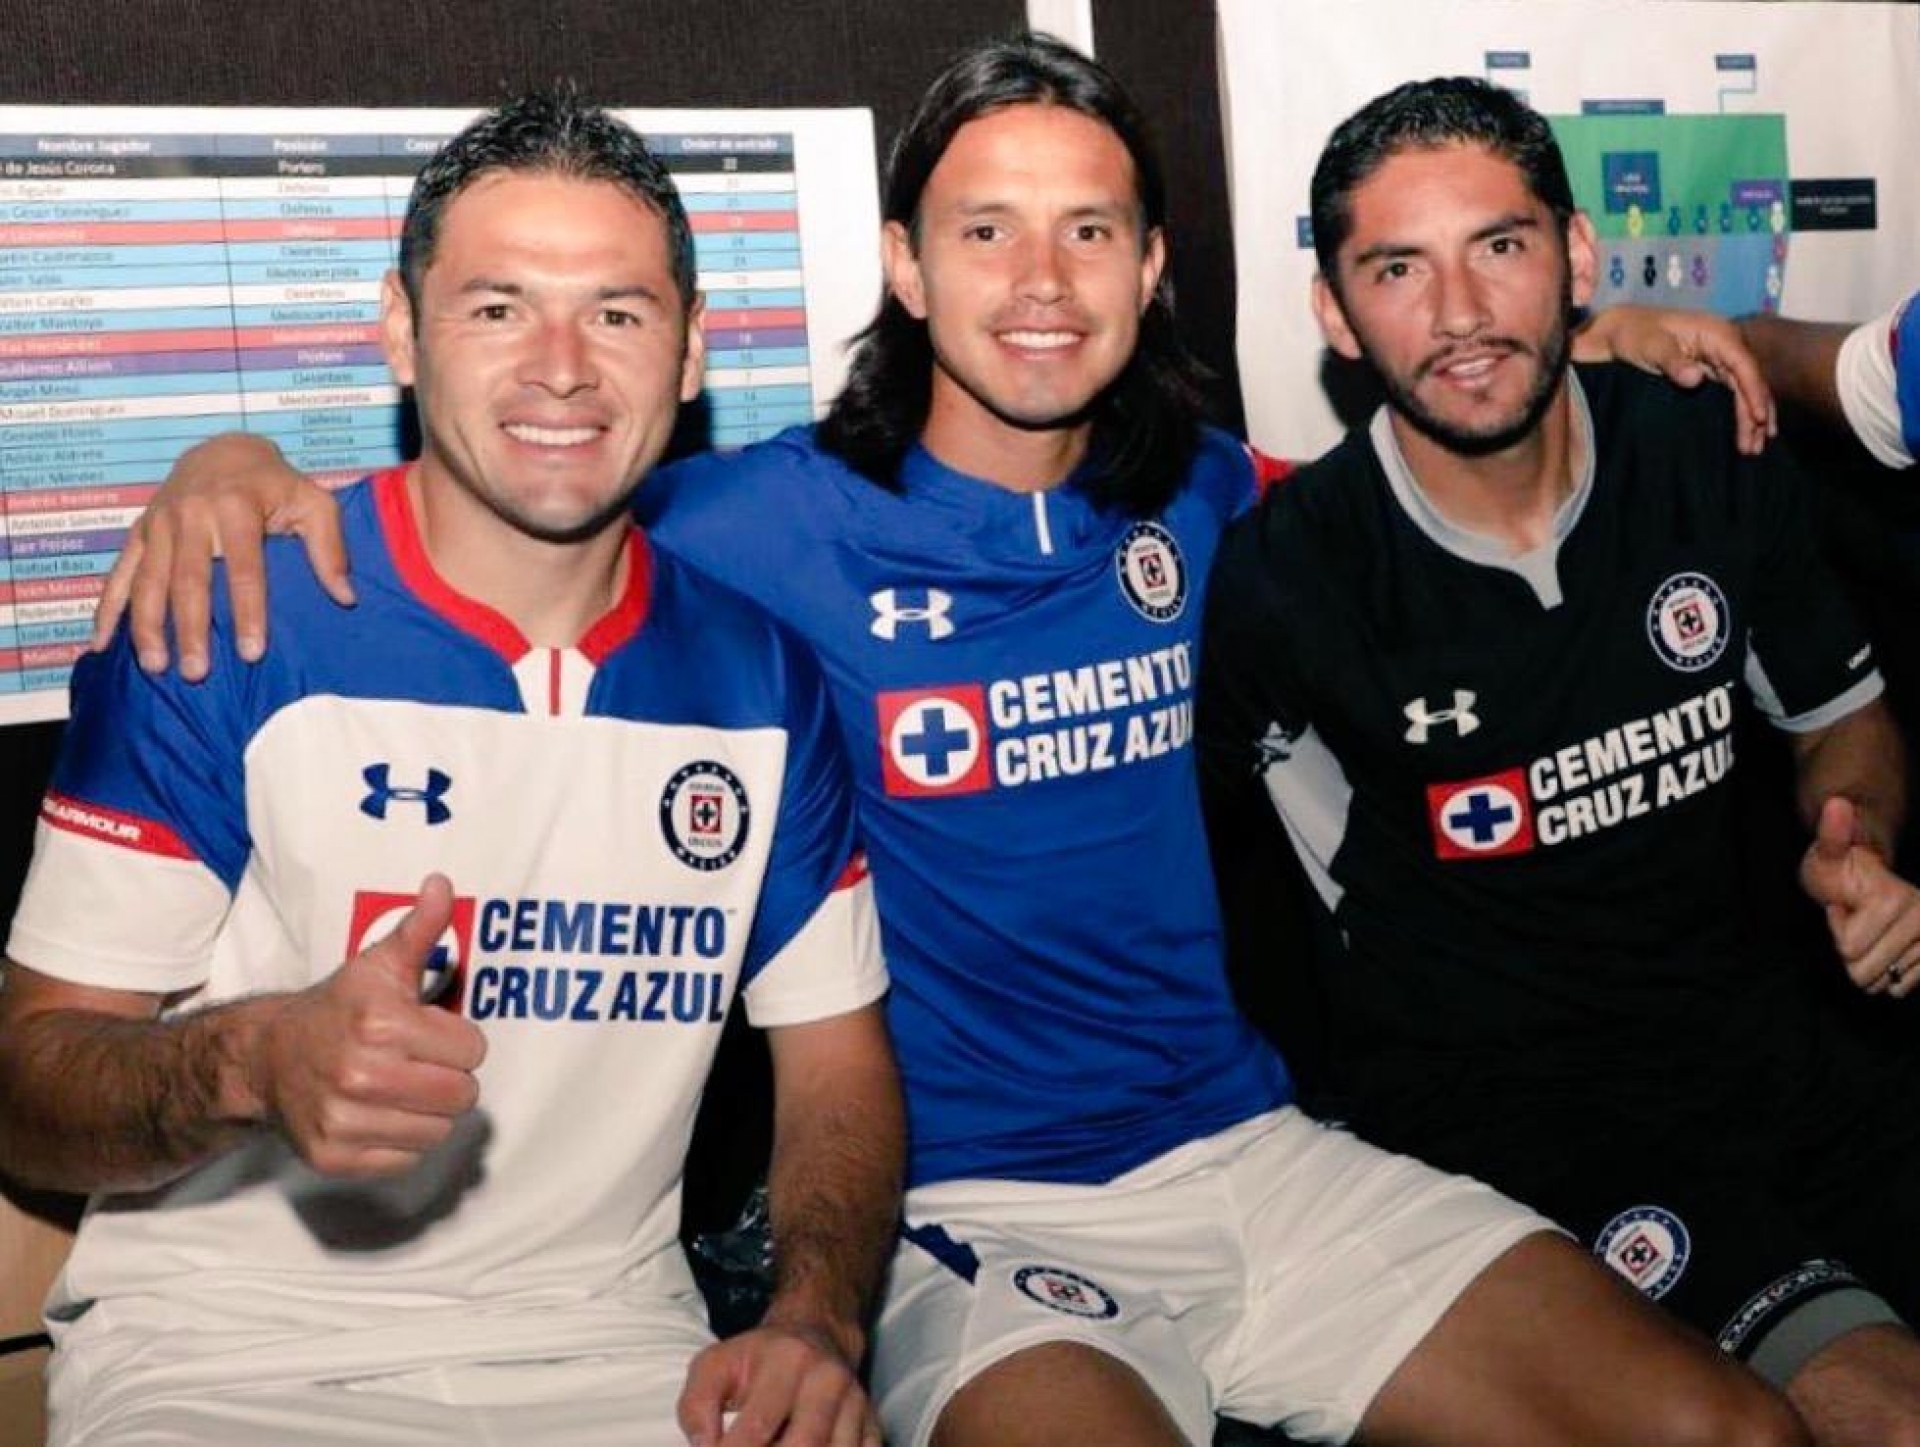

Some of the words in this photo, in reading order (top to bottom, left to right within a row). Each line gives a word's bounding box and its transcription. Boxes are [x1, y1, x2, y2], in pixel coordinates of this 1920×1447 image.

[66, 160, 115, 175] Corona
[988, 642, 1191, 729] CEMENTO
[995, 721, 1117, 787] CRUZ
[1529, 686, 1732, 801] CEMENTO
[1536, 773, 1651, 846] CRUZ
[479, 898, 726, 959] CEMENTO
[469, 967, 600, 1021] CRUZ
[608, 970, 724, 1023] AZUL
